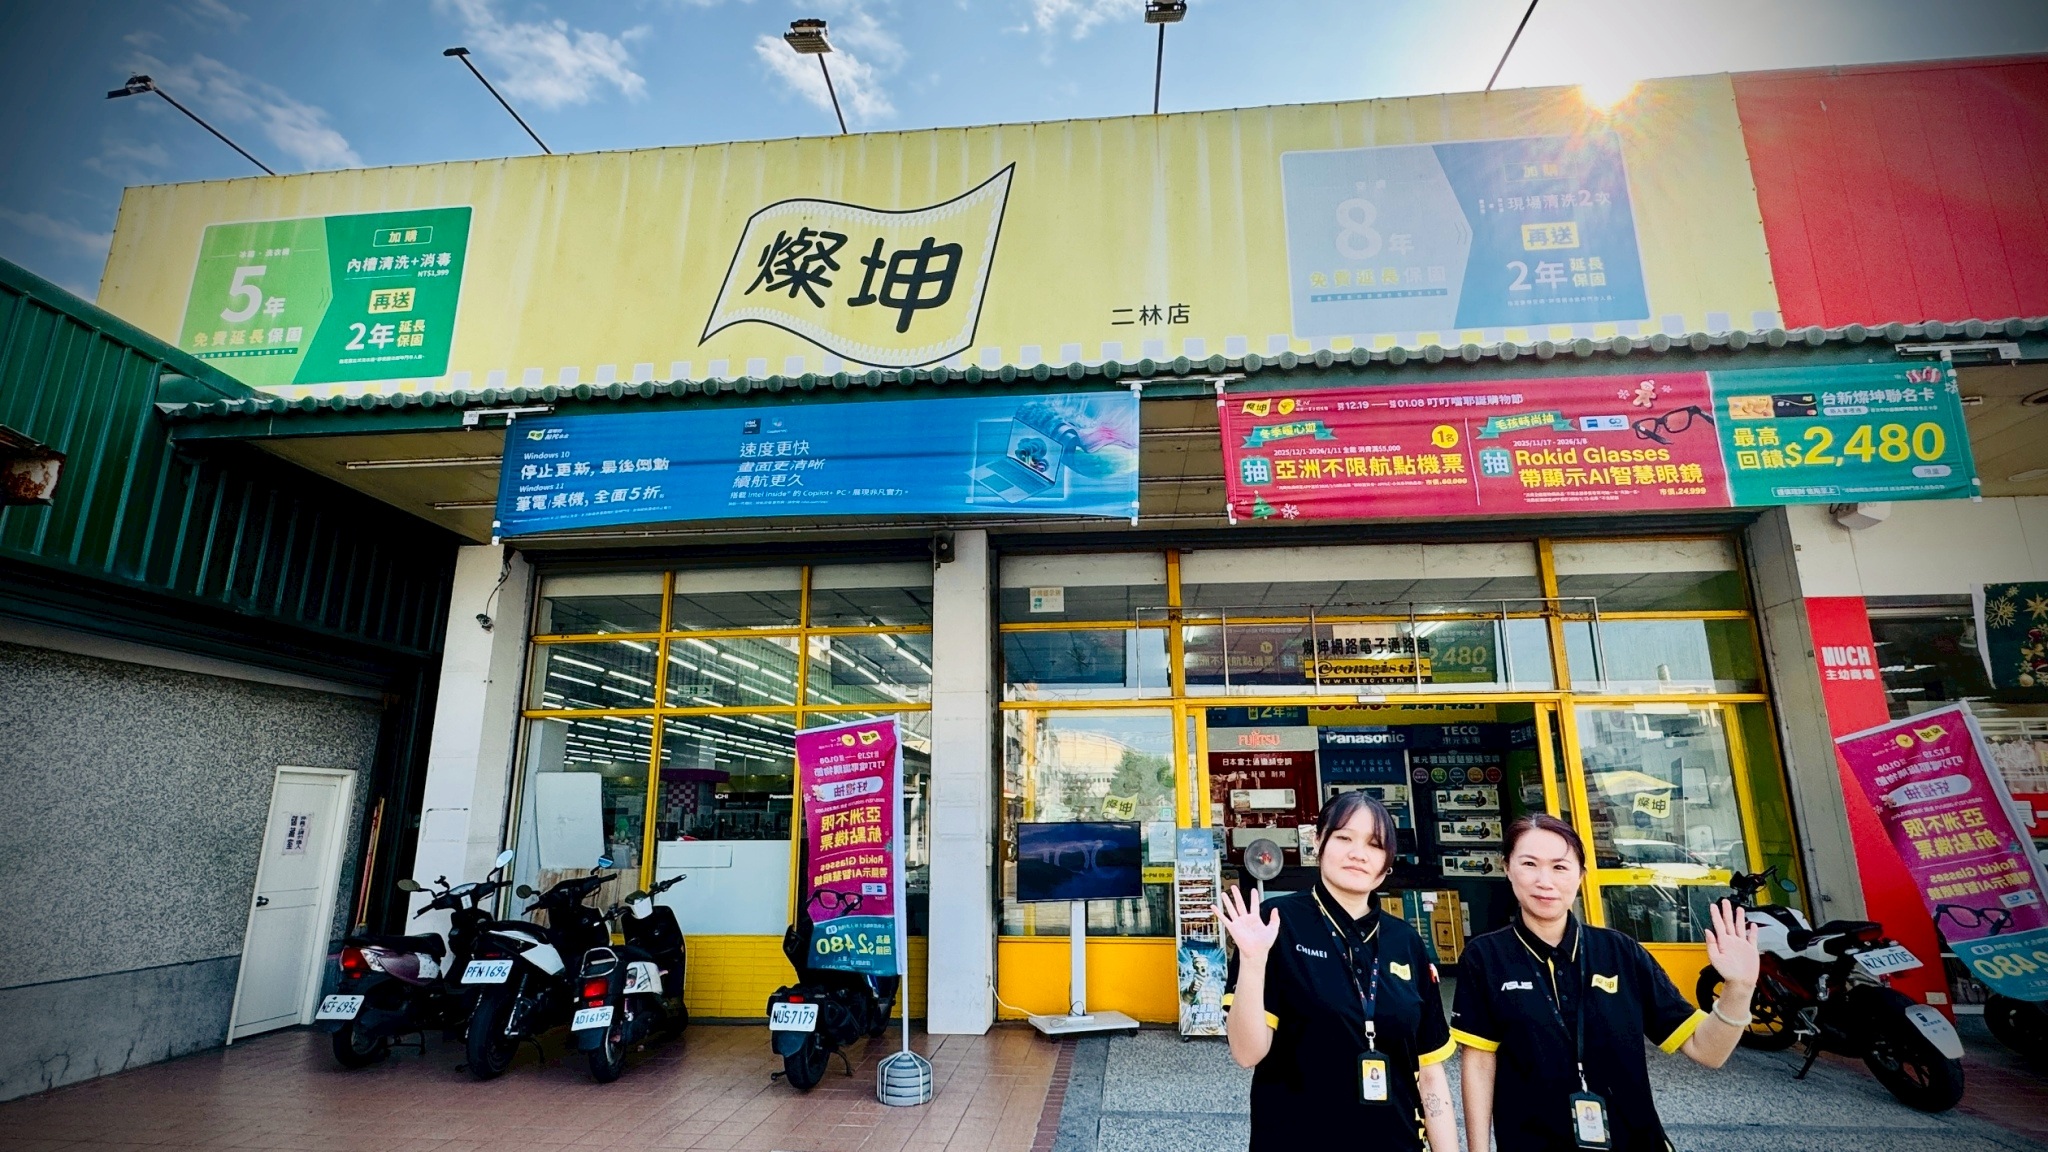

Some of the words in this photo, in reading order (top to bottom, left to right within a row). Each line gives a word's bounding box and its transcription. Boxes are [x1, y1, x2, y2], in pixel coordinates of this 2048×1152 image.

[388, 230, 418, 243] 加購
[1527, 226, 1574, 247] 再送
[744, 226, 962, 334] 燦坤
[1309, 265, 1447, 289] 免費延長保固
[1506, 259, 1569, 292] 2年
[373, 291, 412, 311] 再送
[1111, 303, 1192, 327] 二林店
[399, 320, 426, 333] 延長
[192, 325, 303, 348] 免費延長保固
[345, 323, 395, 352] 2年
[396, 333, 424, 348] 保固
[1821, 387, 1936, 406] 台新燦坤聯名卡
[1732, 427, 1781, 448] 最高
[1737, 449, 1785, 470] 回饋
[1784, 422, 1946, 468] $2,480
[523, 452, 559, 461] Windows
[561, 450, 571, 459] 10
[739, 440, 811, 458] 速度更快
[1515, 448, 1578, 466] Rokid
[1583, 447, 1671, 464] Glasses
[737, 458, 827, 473] 畫面更清晰
[1244, 461, 1269, 483] 抽
[1274, 453, 1465, 480] 亞洲不限航點機票
[1483, 452, 1510, 475] 抽
[731, 473, 805, 489] 續航更久
[1519, 464, 1705, 489] 帶顯示AI智慧眼鏡
[519, 484, 555, 493] Windows
[555, 482, 565, 490] 11
[1821, 645, 1872, 667] MUCH
[1238, 729, 1281, 748] FUJITSU
[1326, 731, 1405, 745] Panasonic
[1442, 725, 1480, 736] TECO
[1105, 798, 1134, 816] 燦坤
[1637, 797, 1667, 814] 燦坤
[1296, 944, 1328, 959] CHIMEI
[1501, 980, 1534, 991] ASUS
